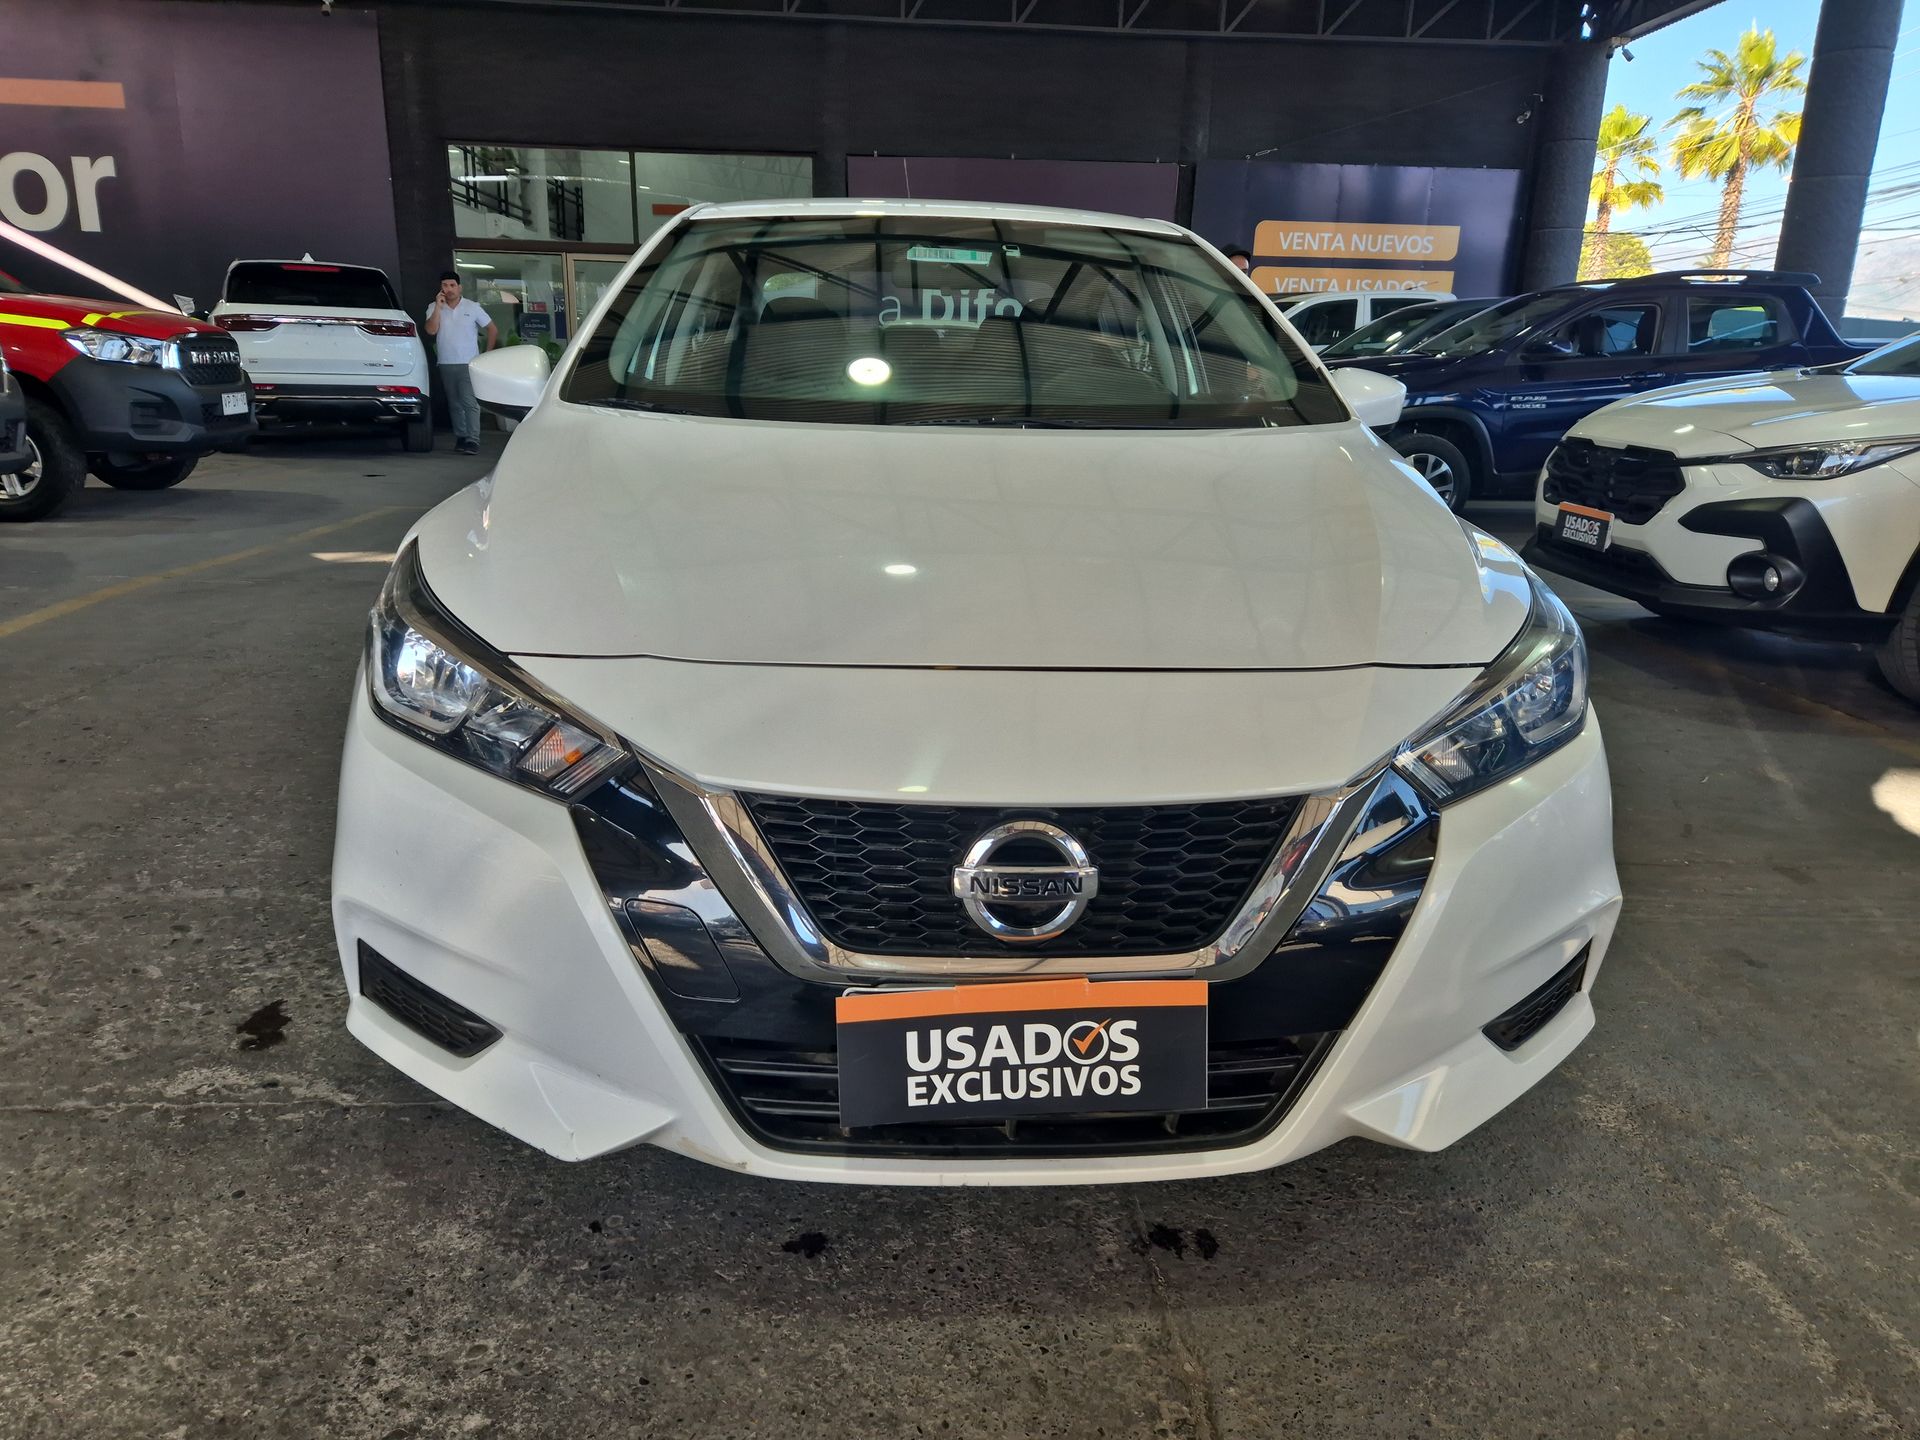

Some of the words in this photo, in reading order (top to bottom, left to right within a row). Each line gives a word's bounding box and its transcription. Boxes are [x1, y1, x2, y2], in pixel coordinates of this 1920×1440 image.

[0, 152, 117, 232] or
[1279, 231, 1345, 251] VENTA
[1351, 233, 1434, 254] NUEVOS
[1275, 277, 1340, 293] VENTA
[1564, 514, 1601, 535] USADOS
[1562, 528, 1598, 545] EXCLUSIVOS
[970, 876, 1083, 896] NISSAN
[906, 1019, 1140, 1072] USADOS
[907, 1064, 1142, 1107] EXCLUSIVOS
